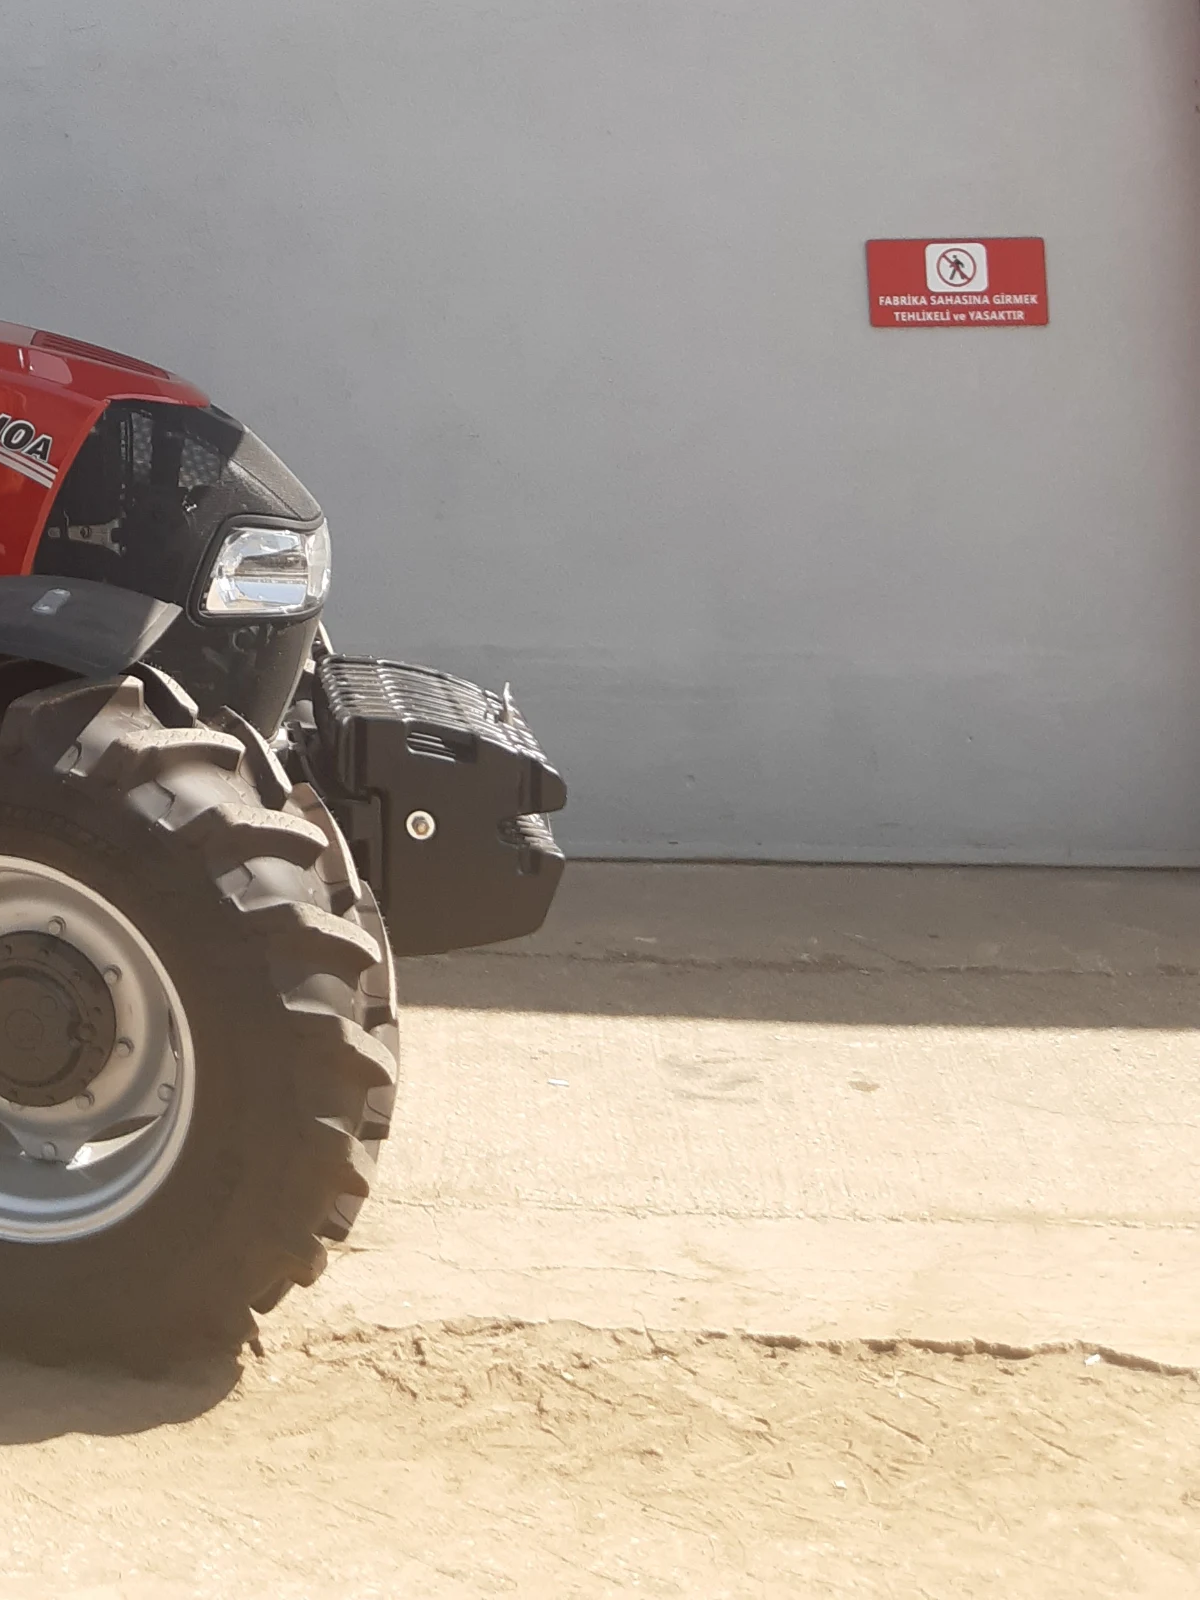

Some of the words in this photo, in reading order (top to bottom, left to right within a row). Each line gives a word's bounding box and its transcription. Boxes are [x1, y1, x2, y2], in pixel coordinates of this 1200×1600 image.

[878, 293, 928, 306] FABRİKA
[929, 294, 990, 306] SAHASINA
[992, 292, 1039, 305] GİRMEK
[893, 309, 951, 322] TEHLİKELİ
[952, 313, 966, 321] ve
[968, 310, 1025, 321] YASAKTIR
